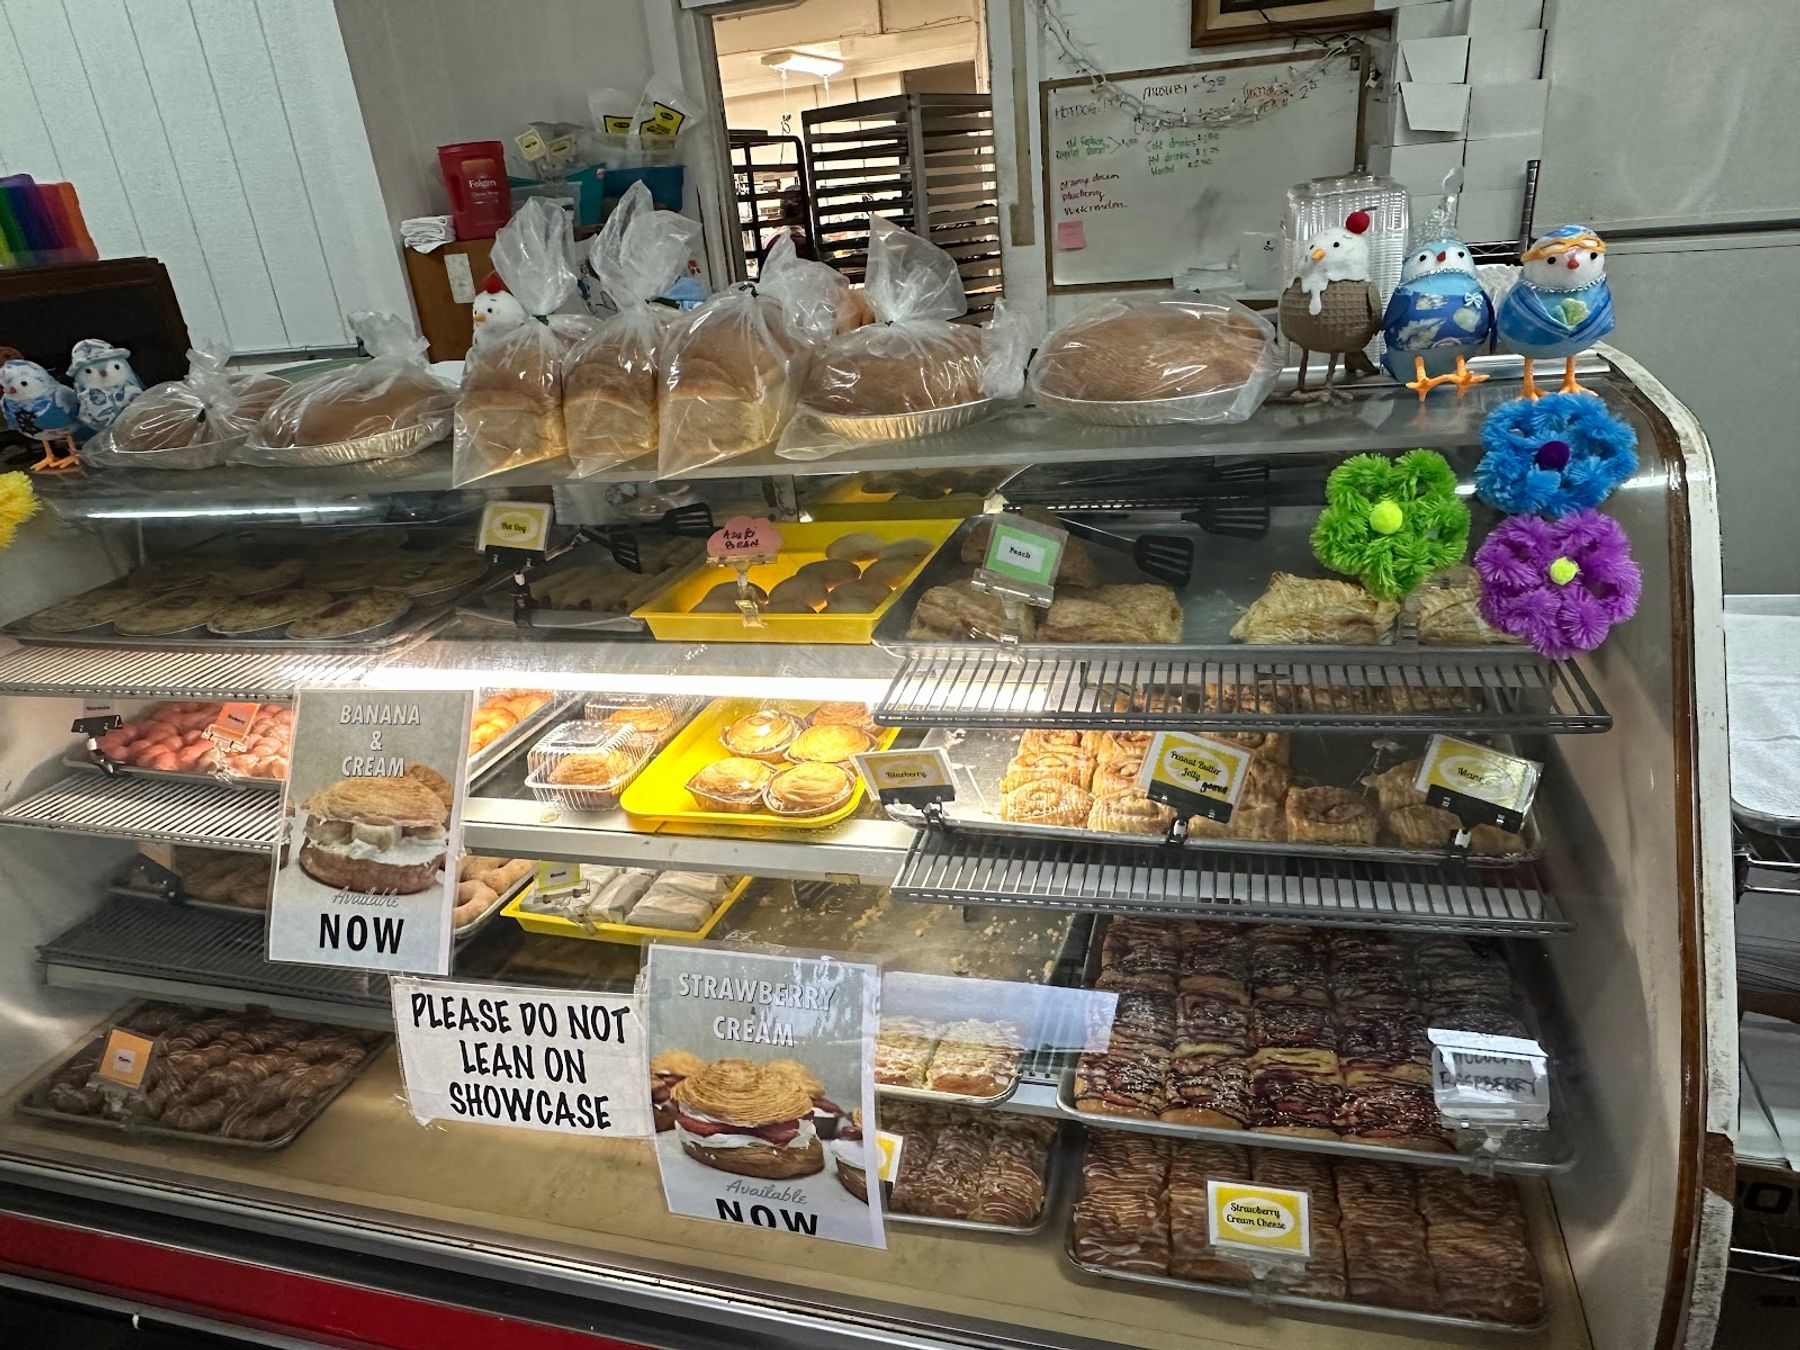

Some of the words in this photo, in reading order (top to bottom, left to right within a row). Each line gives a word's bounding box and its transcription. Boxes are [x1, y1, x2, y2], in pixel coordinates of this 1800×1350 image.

[725, 539, 759, 550] BEAN
[1009, 546, 1032, 560] Peach
[339, 704, 422, 726] BANANA
[369, 730, 384, 752] &
[341, 756, 406, 779] CREAM
[1170, 750, 1197, 767] Peanut
[1198, 761, 1222, 776] Butter
[1181, 767, 1202, 782] Jelly
[332, 885, 401, 909] Available
[318, 912, 405, 955] NOW
[678, 971, 841, 1012] STRAWBERRY
[410, 992, 513, 1035] PLEASE
[518, 1002, 558, 1038] DO
[566, 1003, 631, 1044] NOT
[713, 1016, 796, 1047] CREAM
[458, 1039, 536, 1081] LEAN
[543, 1046, 588, 1085] ON
[448, 1081, 612, 1130] SHOWCASE
[726, 1178, 808, 1205] Available
[715, 1198, 819, 1236] NOW
[1226, 1213, 1256, 1226] Cream
[1256, 1217, 1288, 1229] Cheese
[1230, 1202, 1282, 1219] Strawberry
